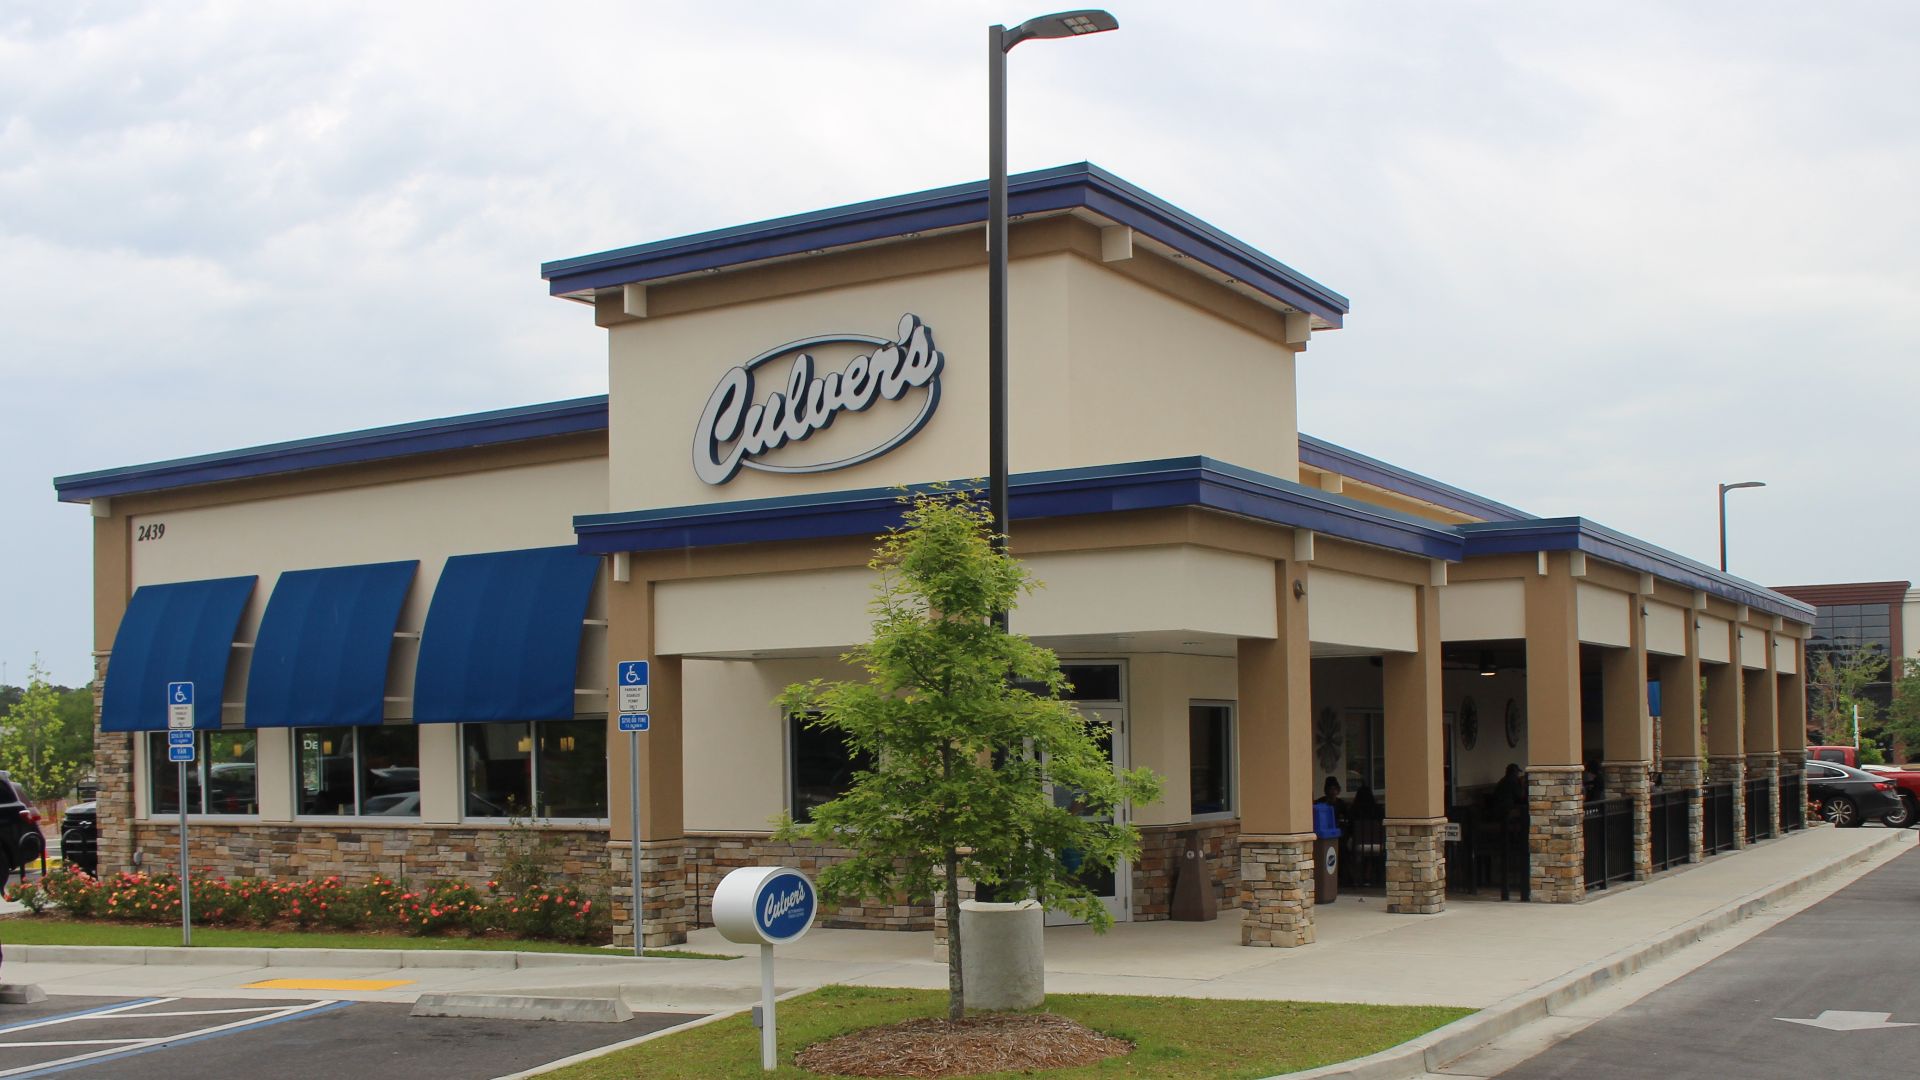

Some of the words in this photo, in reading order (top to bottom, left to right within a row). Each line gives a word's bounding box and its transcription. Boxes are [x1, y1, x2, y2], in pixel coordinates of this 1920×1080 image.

[692, 313, 944, 485] Culver's
[138, 523, 165, 541] 2439
[763, 881, 806, 928] Culver's
